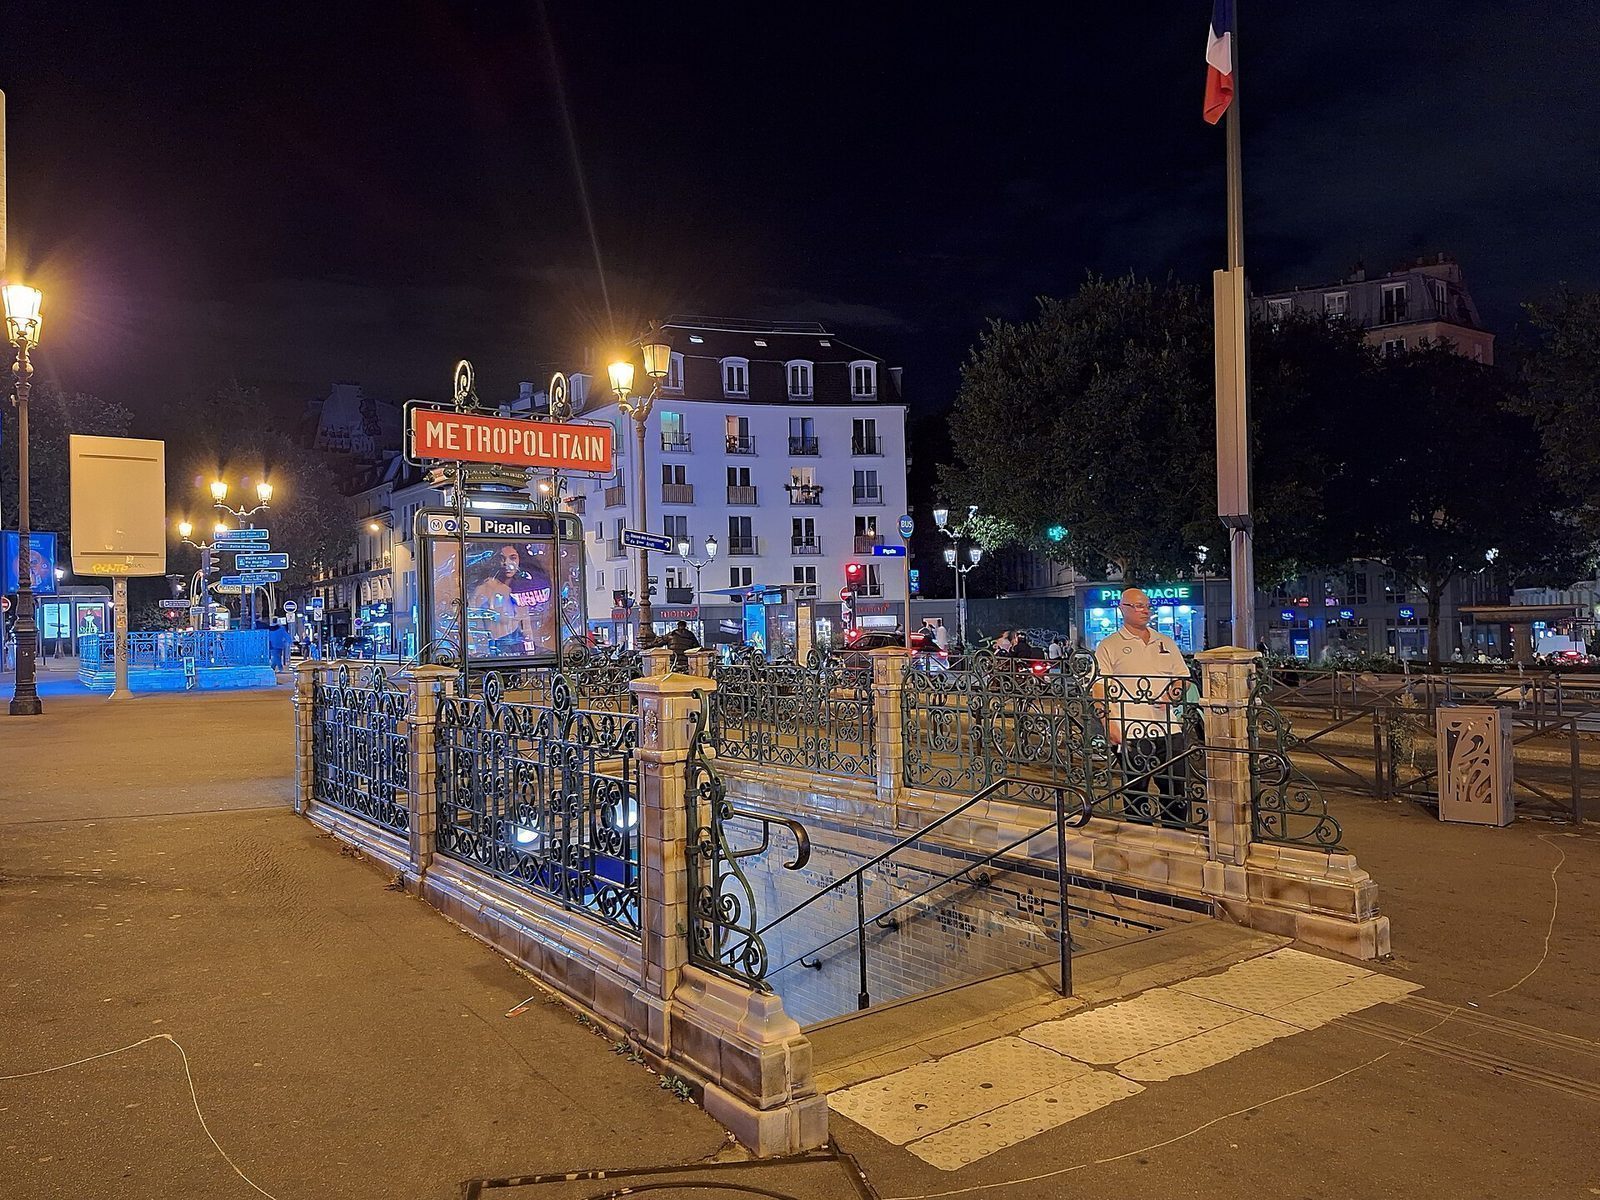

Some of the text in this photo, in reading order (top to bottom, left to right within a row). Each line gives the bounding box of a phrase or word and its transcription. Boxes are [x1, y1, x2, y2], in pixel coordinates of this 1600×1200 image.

[426, 420, 604, 462] METROPOLITAIN
[447, 522, 454, 530] 2
[484, 520, 531, 535] Pigalle
[900, 520, 913, 528] BUS
[1101, 587, 1189, 601] PHMACIE
